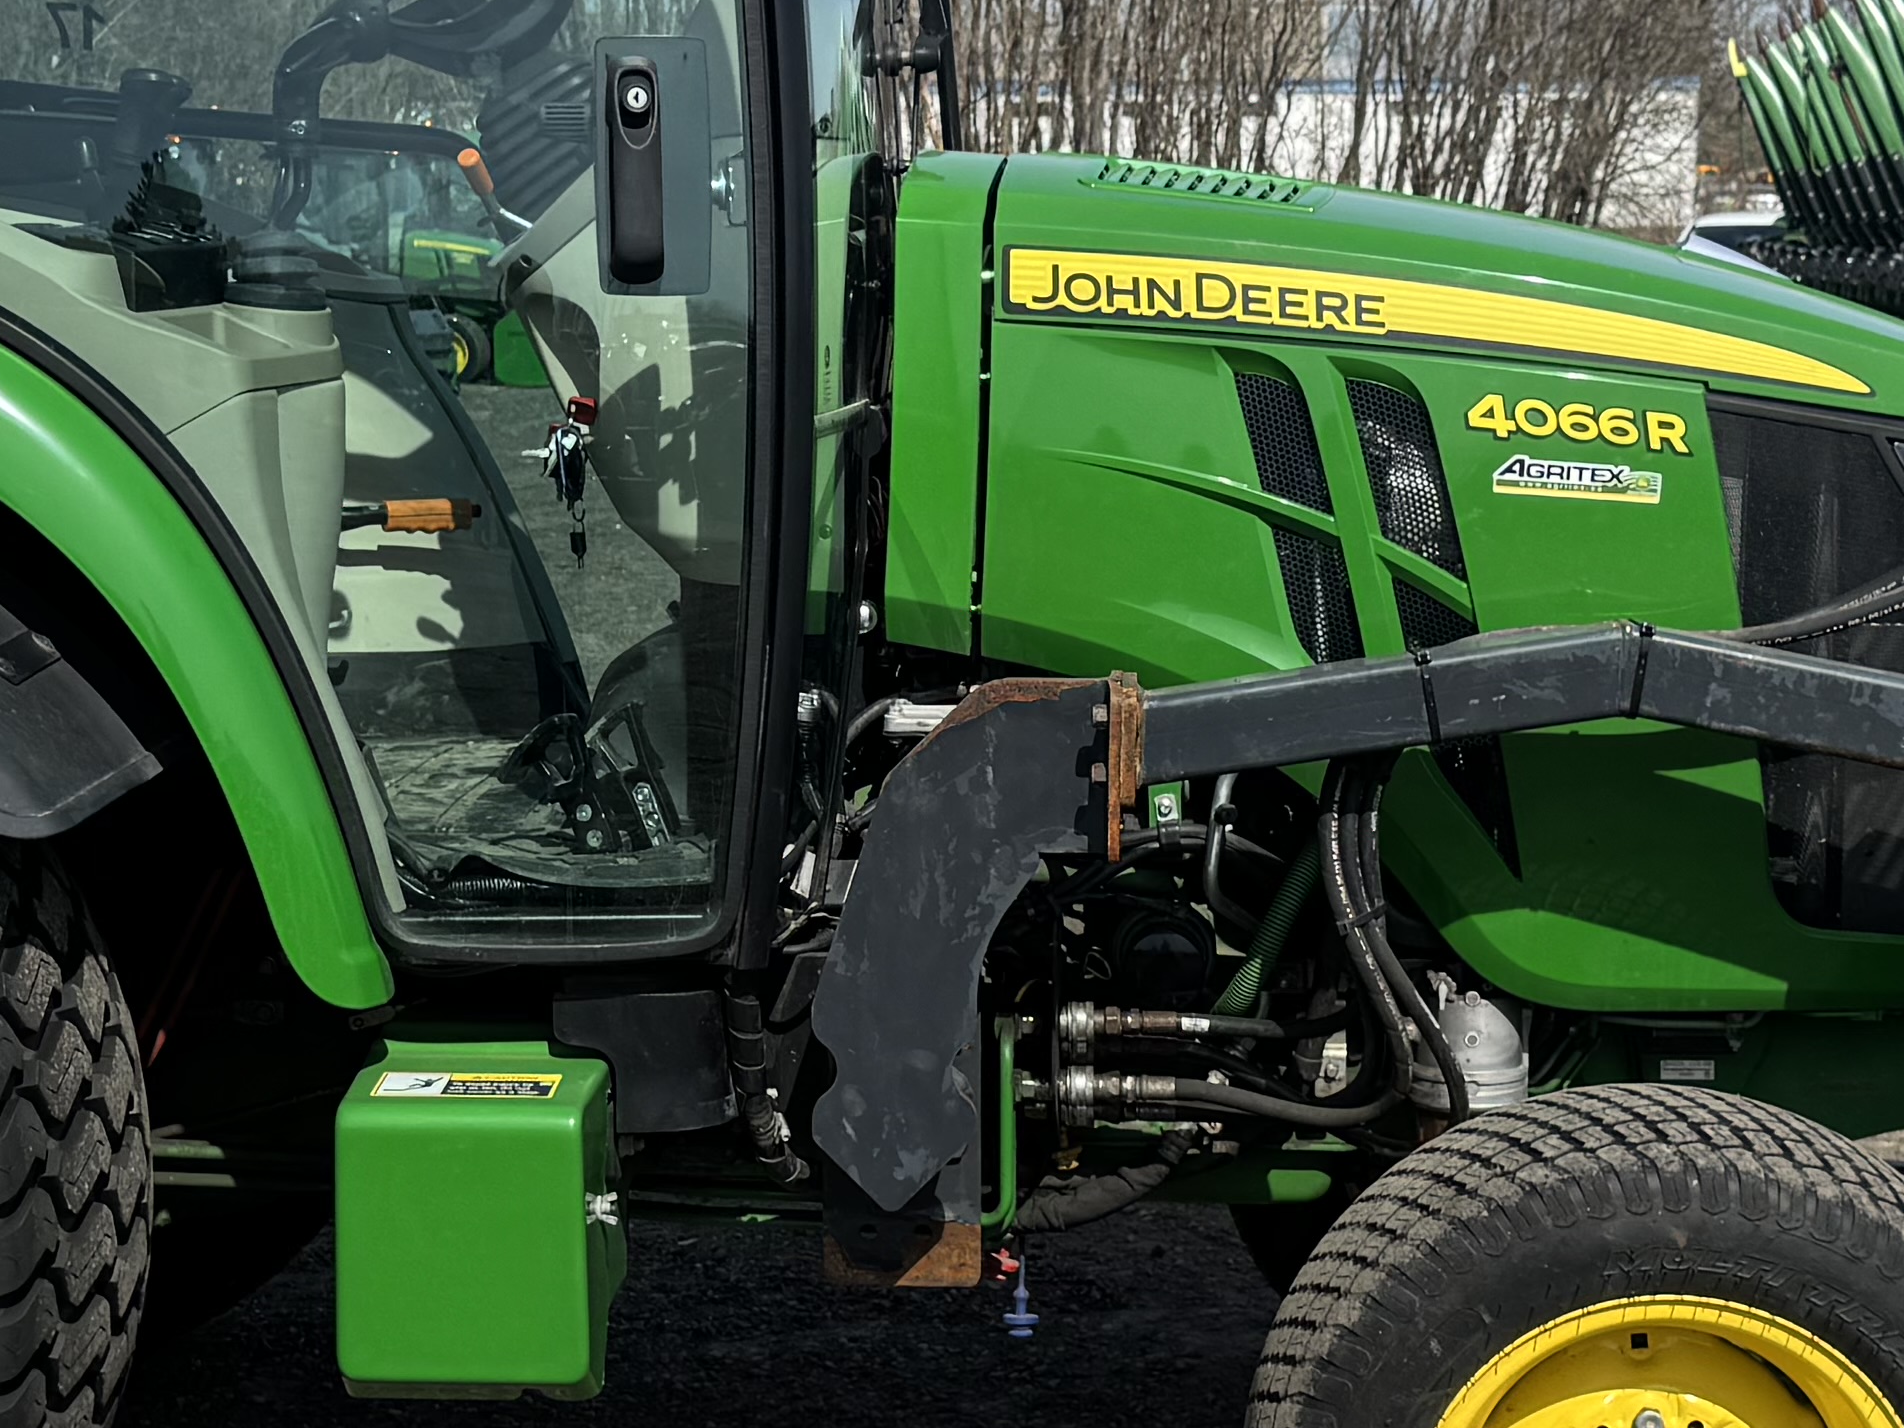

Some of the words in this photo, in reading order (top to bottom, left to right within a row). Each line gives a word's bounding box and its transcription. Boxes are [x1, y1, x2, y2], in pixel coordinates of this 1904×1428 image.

[1032, 263, 1183, 314] JOHN
[1193, 274, 1387, 329] DEERE
[1466, 393, 1690, 455] 4066R
[1497, 457, 1626, 486] AGRITEX
[1603, 1246, 1797, 1288] MULTI
